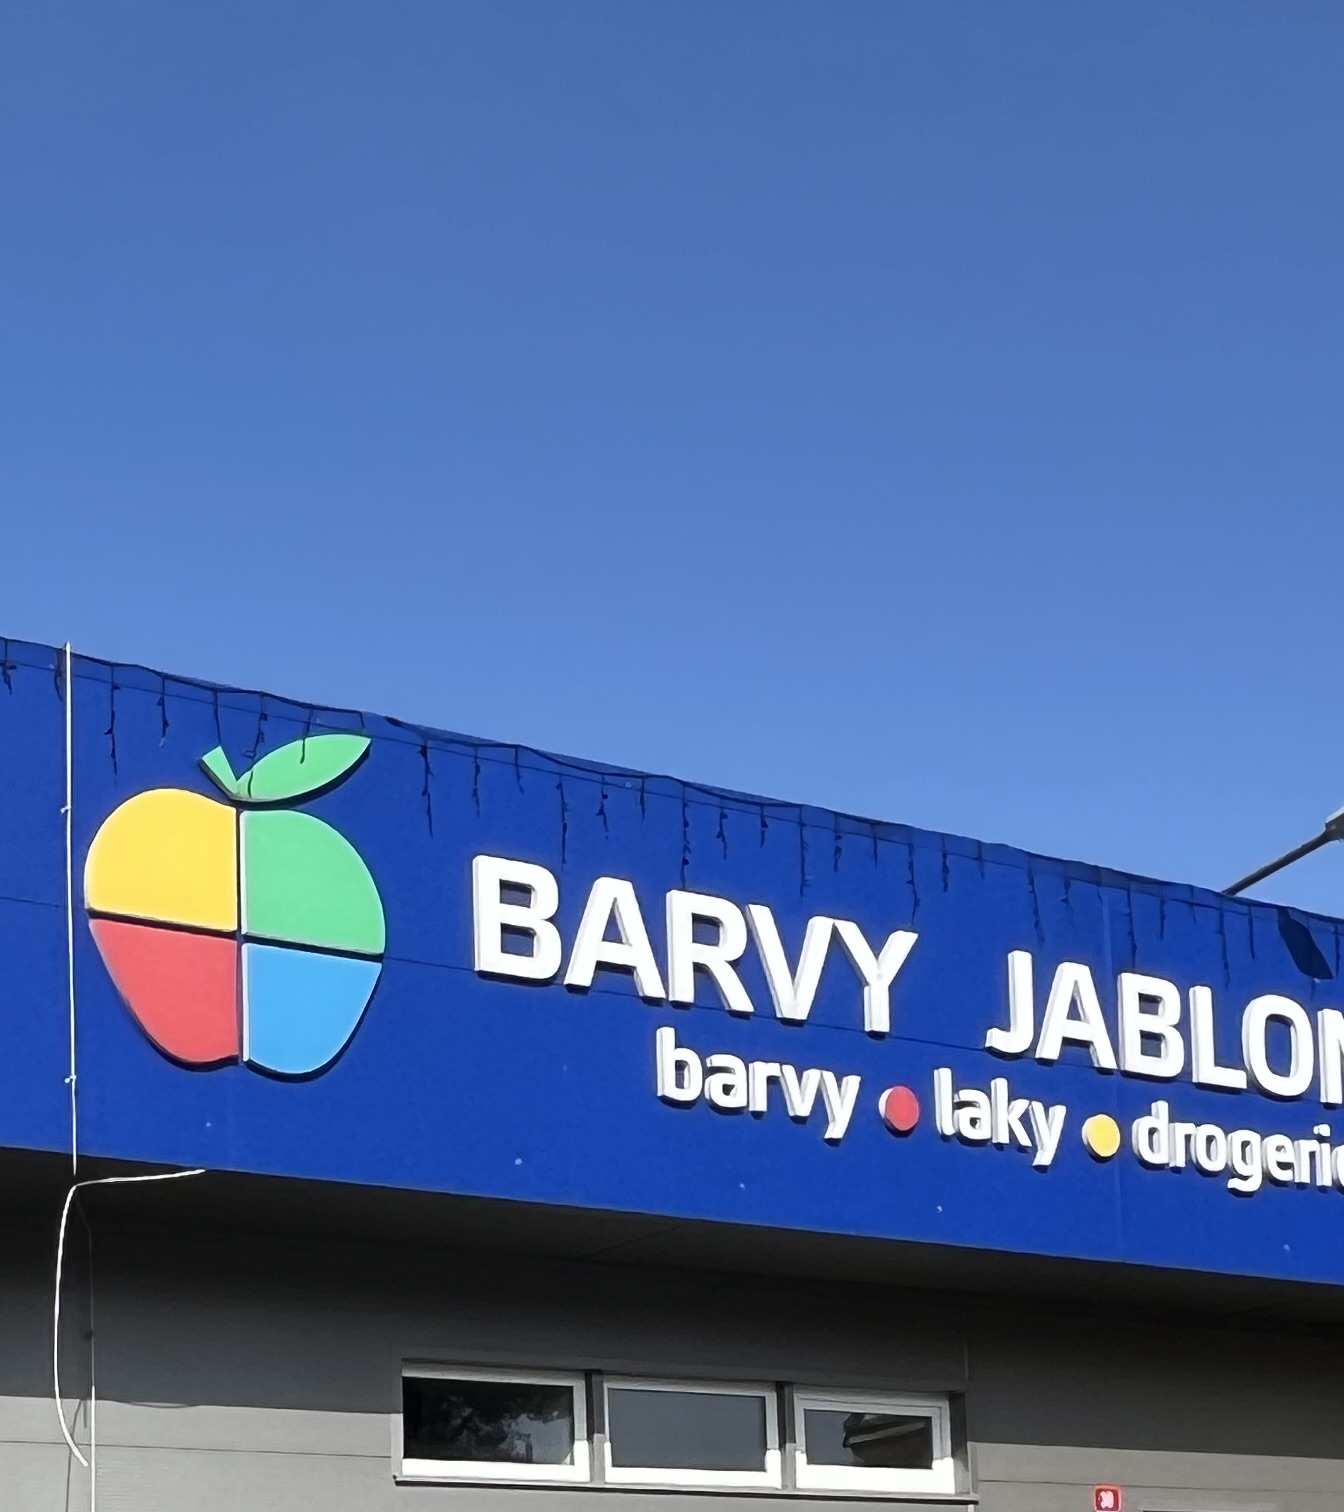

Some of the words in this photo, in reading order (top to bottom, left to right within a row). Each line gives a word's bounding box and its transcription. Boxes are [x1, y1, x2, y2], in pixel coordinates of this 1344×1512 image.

[472, 854, 919, 1035] BARVY
[655, 1026, 862, 1142] barvy
[933, 1067, 1067, 1168] laky
